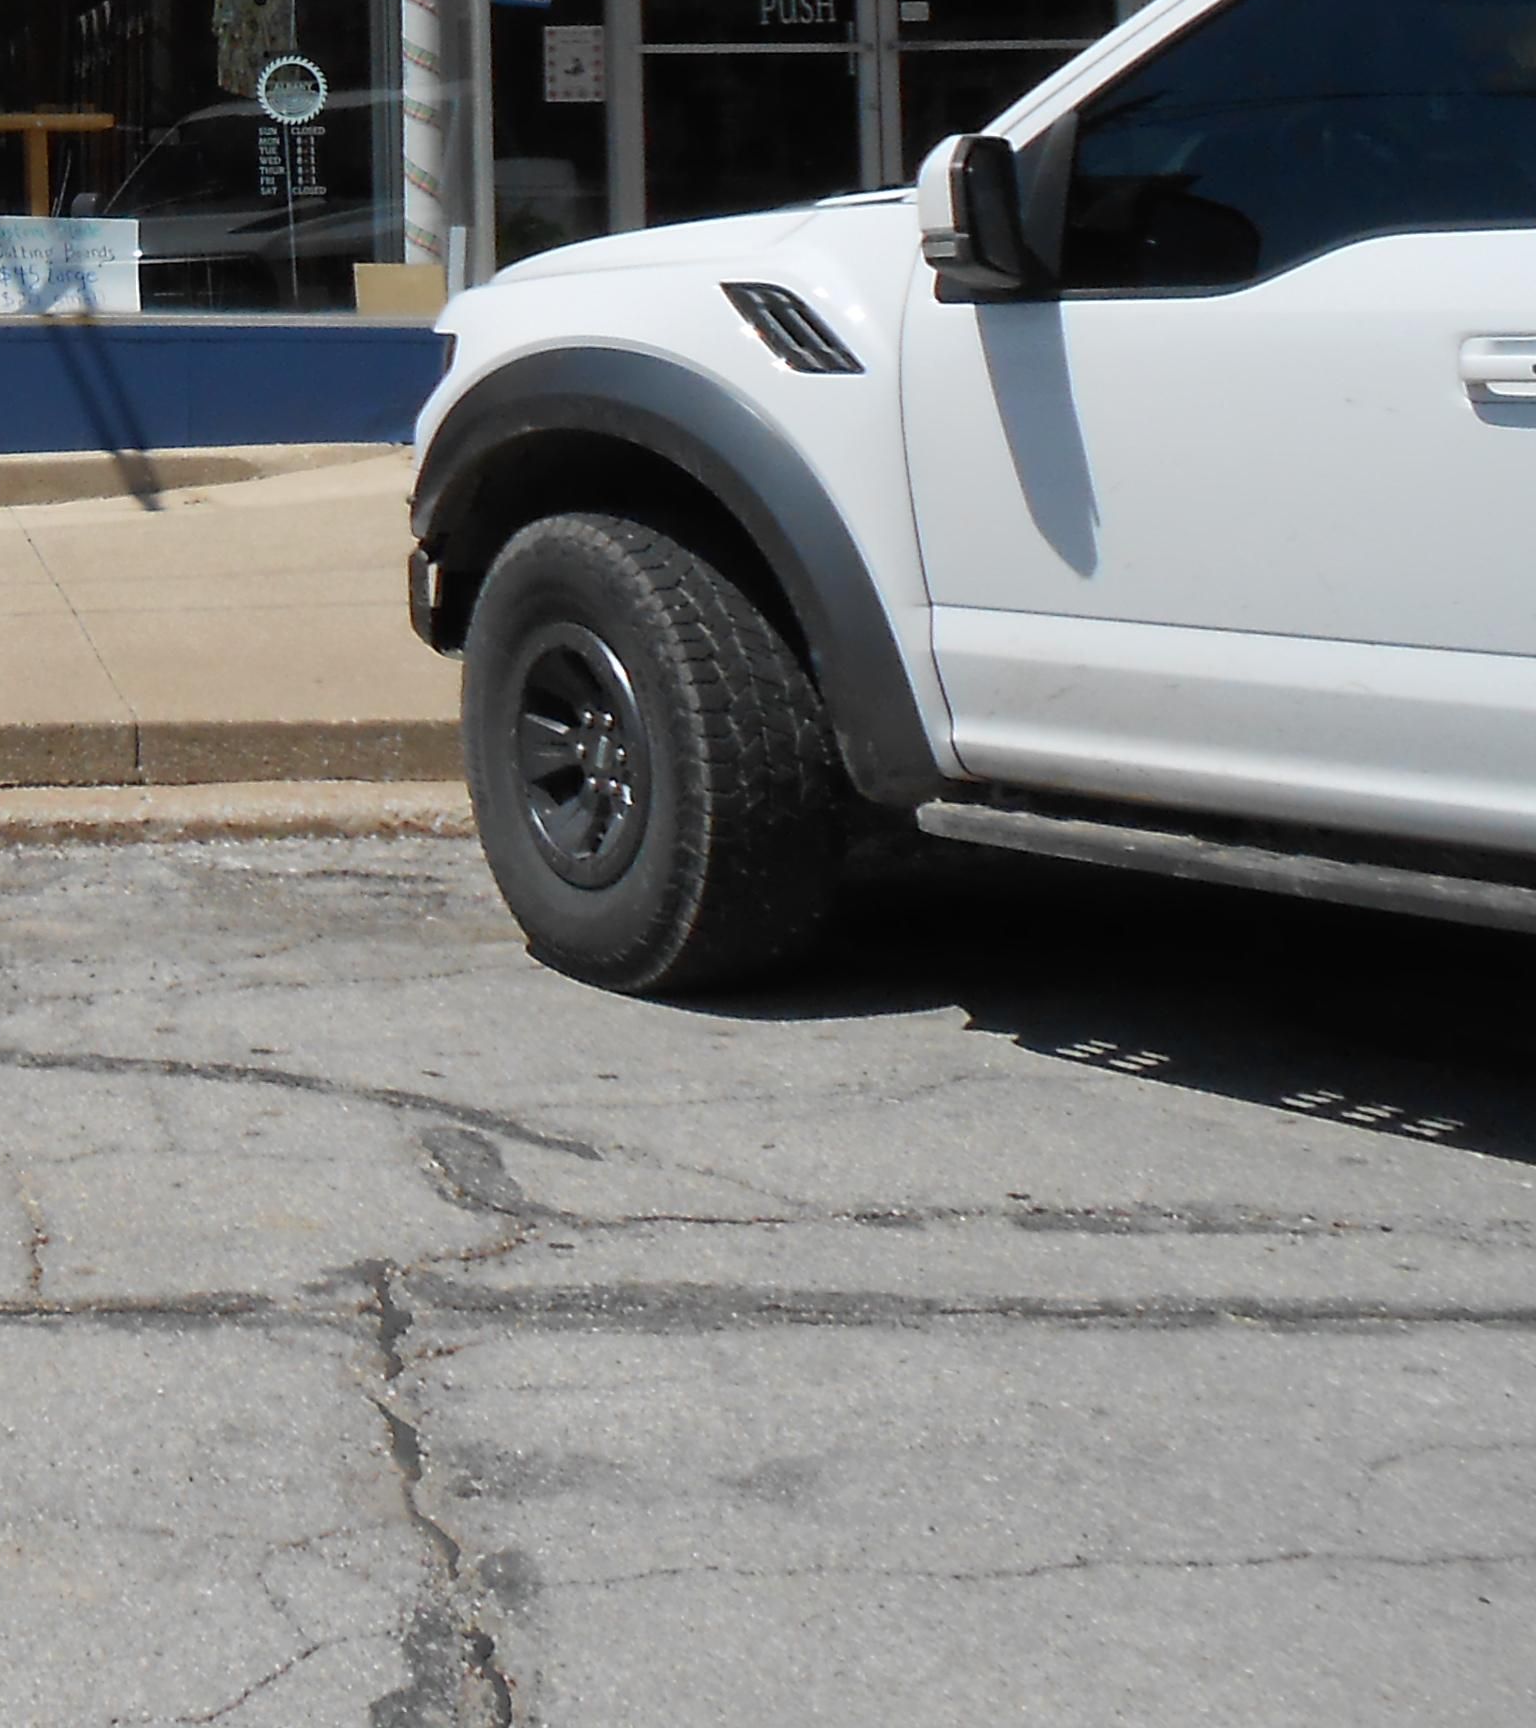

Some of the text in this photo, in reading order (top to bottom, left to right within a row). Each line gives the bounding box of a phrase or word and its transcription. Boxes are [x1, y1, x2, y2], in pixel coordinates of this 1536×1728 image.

[259, 126, 326, 135] SUN CLOSED
[259, 137, 280, 145] MON
[259, 147, 277, 155] TUE
[259, 156, 281, 165] WED
[259, 166, 285, 174] THUR
[260, 176, 275, 185] FRI
[260, 186, 327, 195] SAT CLOSED
